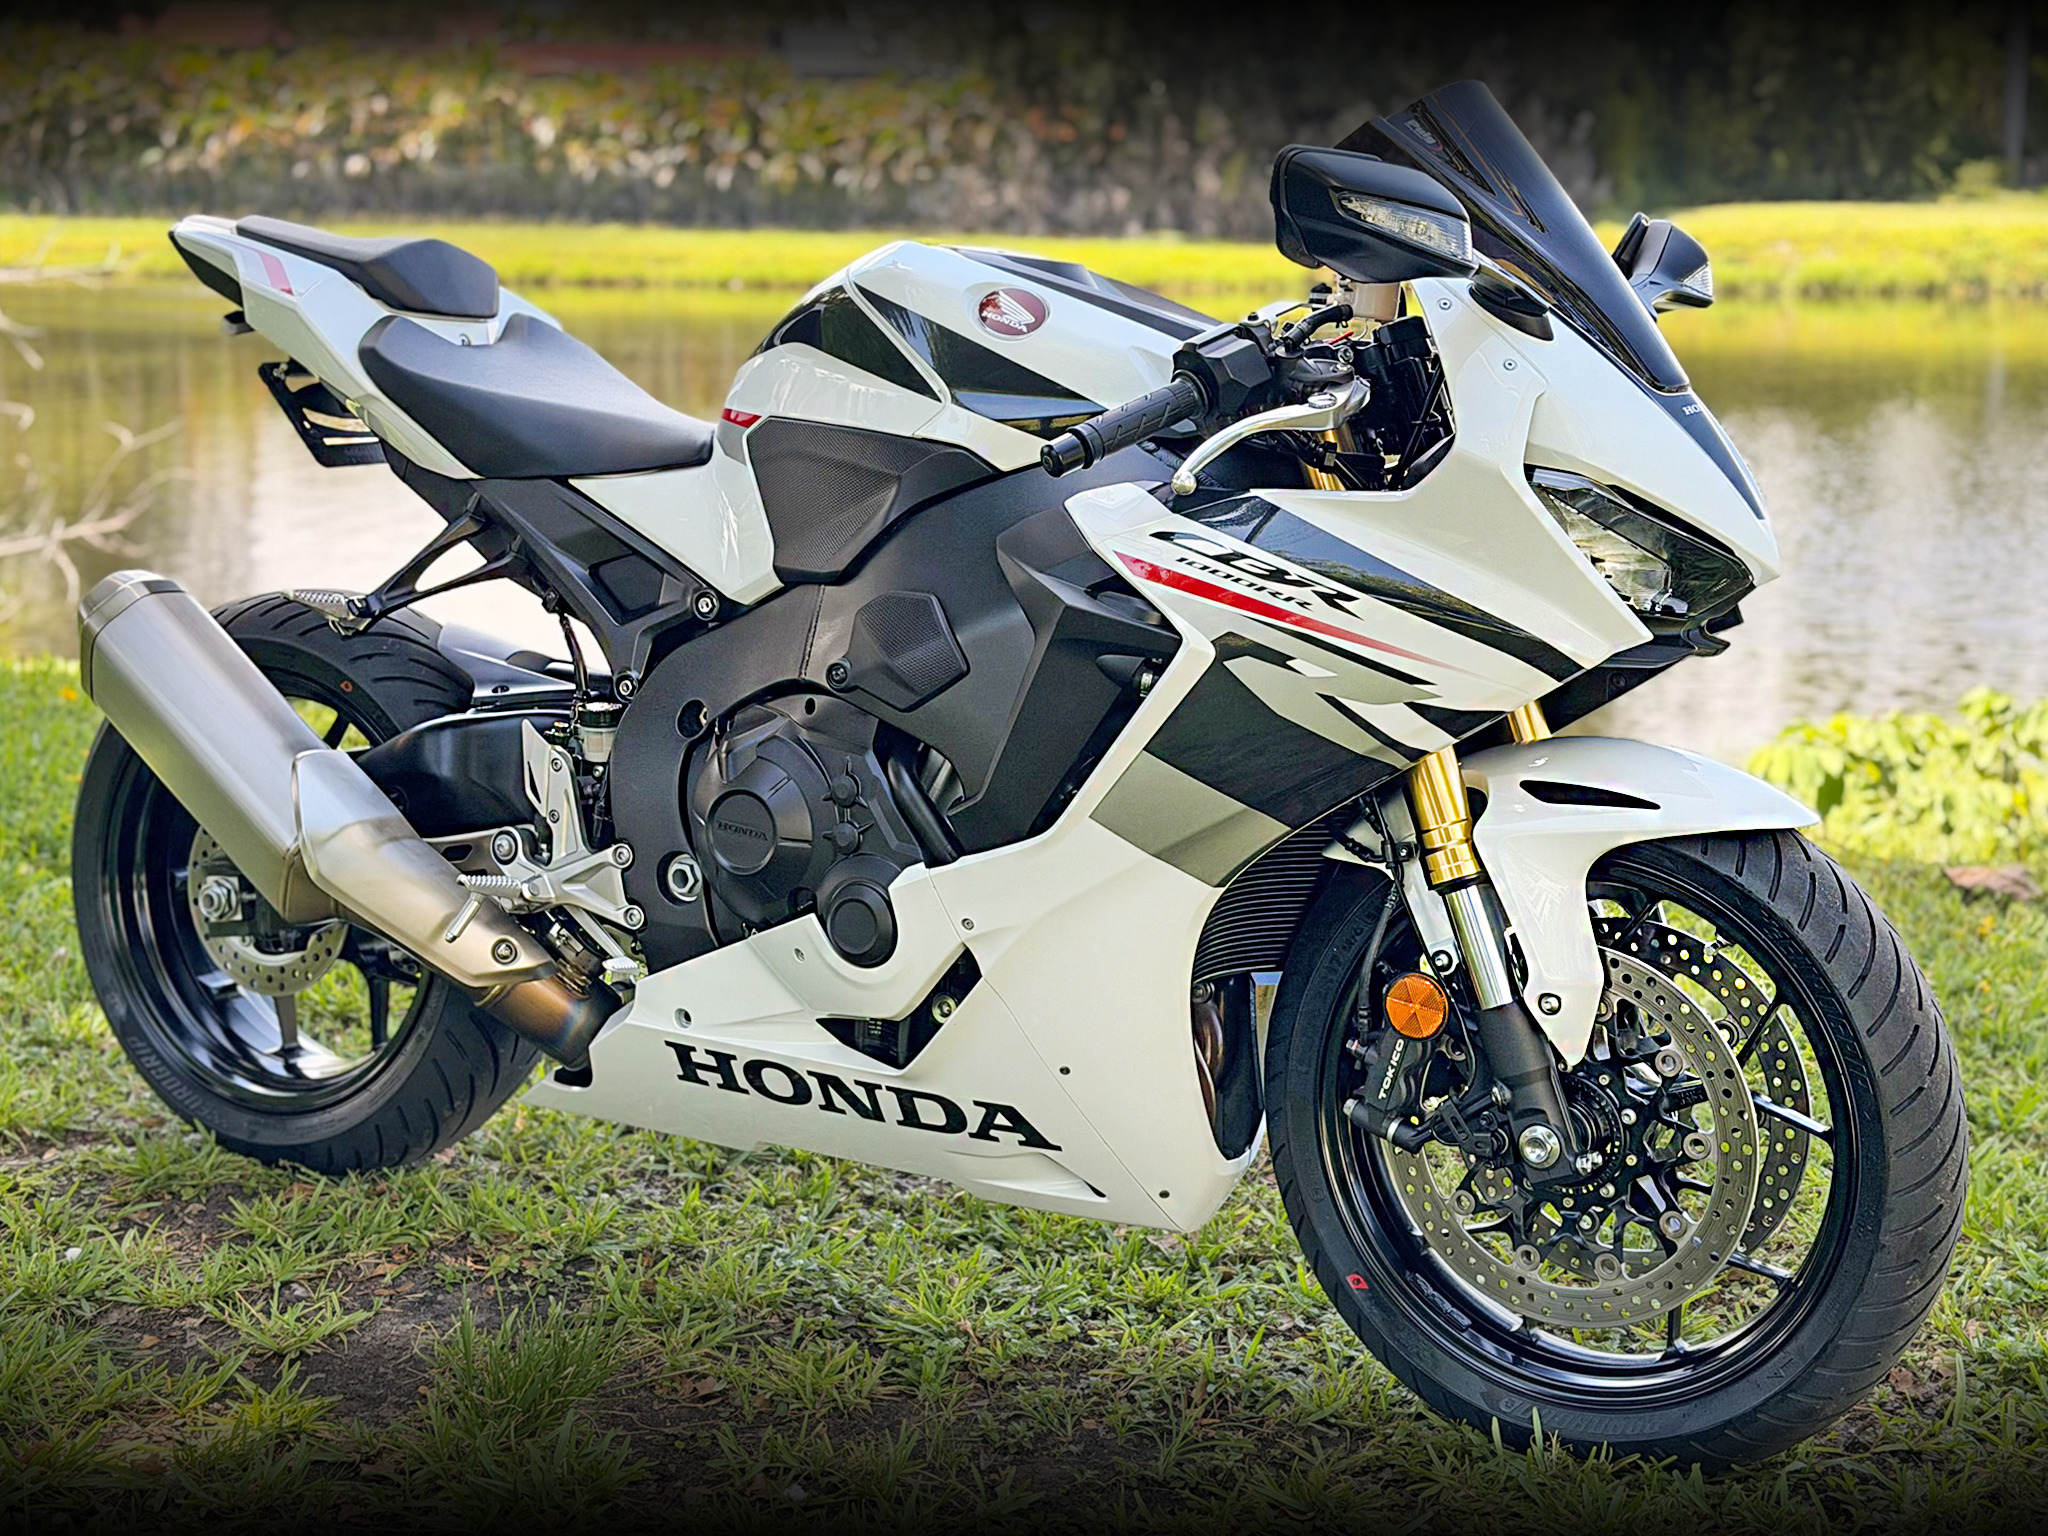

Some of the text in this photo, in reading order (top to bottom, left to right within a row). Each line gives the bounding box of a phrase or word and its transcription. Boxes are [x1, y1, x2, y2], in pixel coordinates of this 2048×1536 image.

[981, 310, 1028, 333] HONDA
[1149, 531, 1365, 622] CBR
[1175, 556, 1315, 612] 1000RR
[716, 820, 769, 841] HONDA
[664, 1040, 1063, 1153] HONDA
[1378, 1039, 1405, 1100] TOKICO
